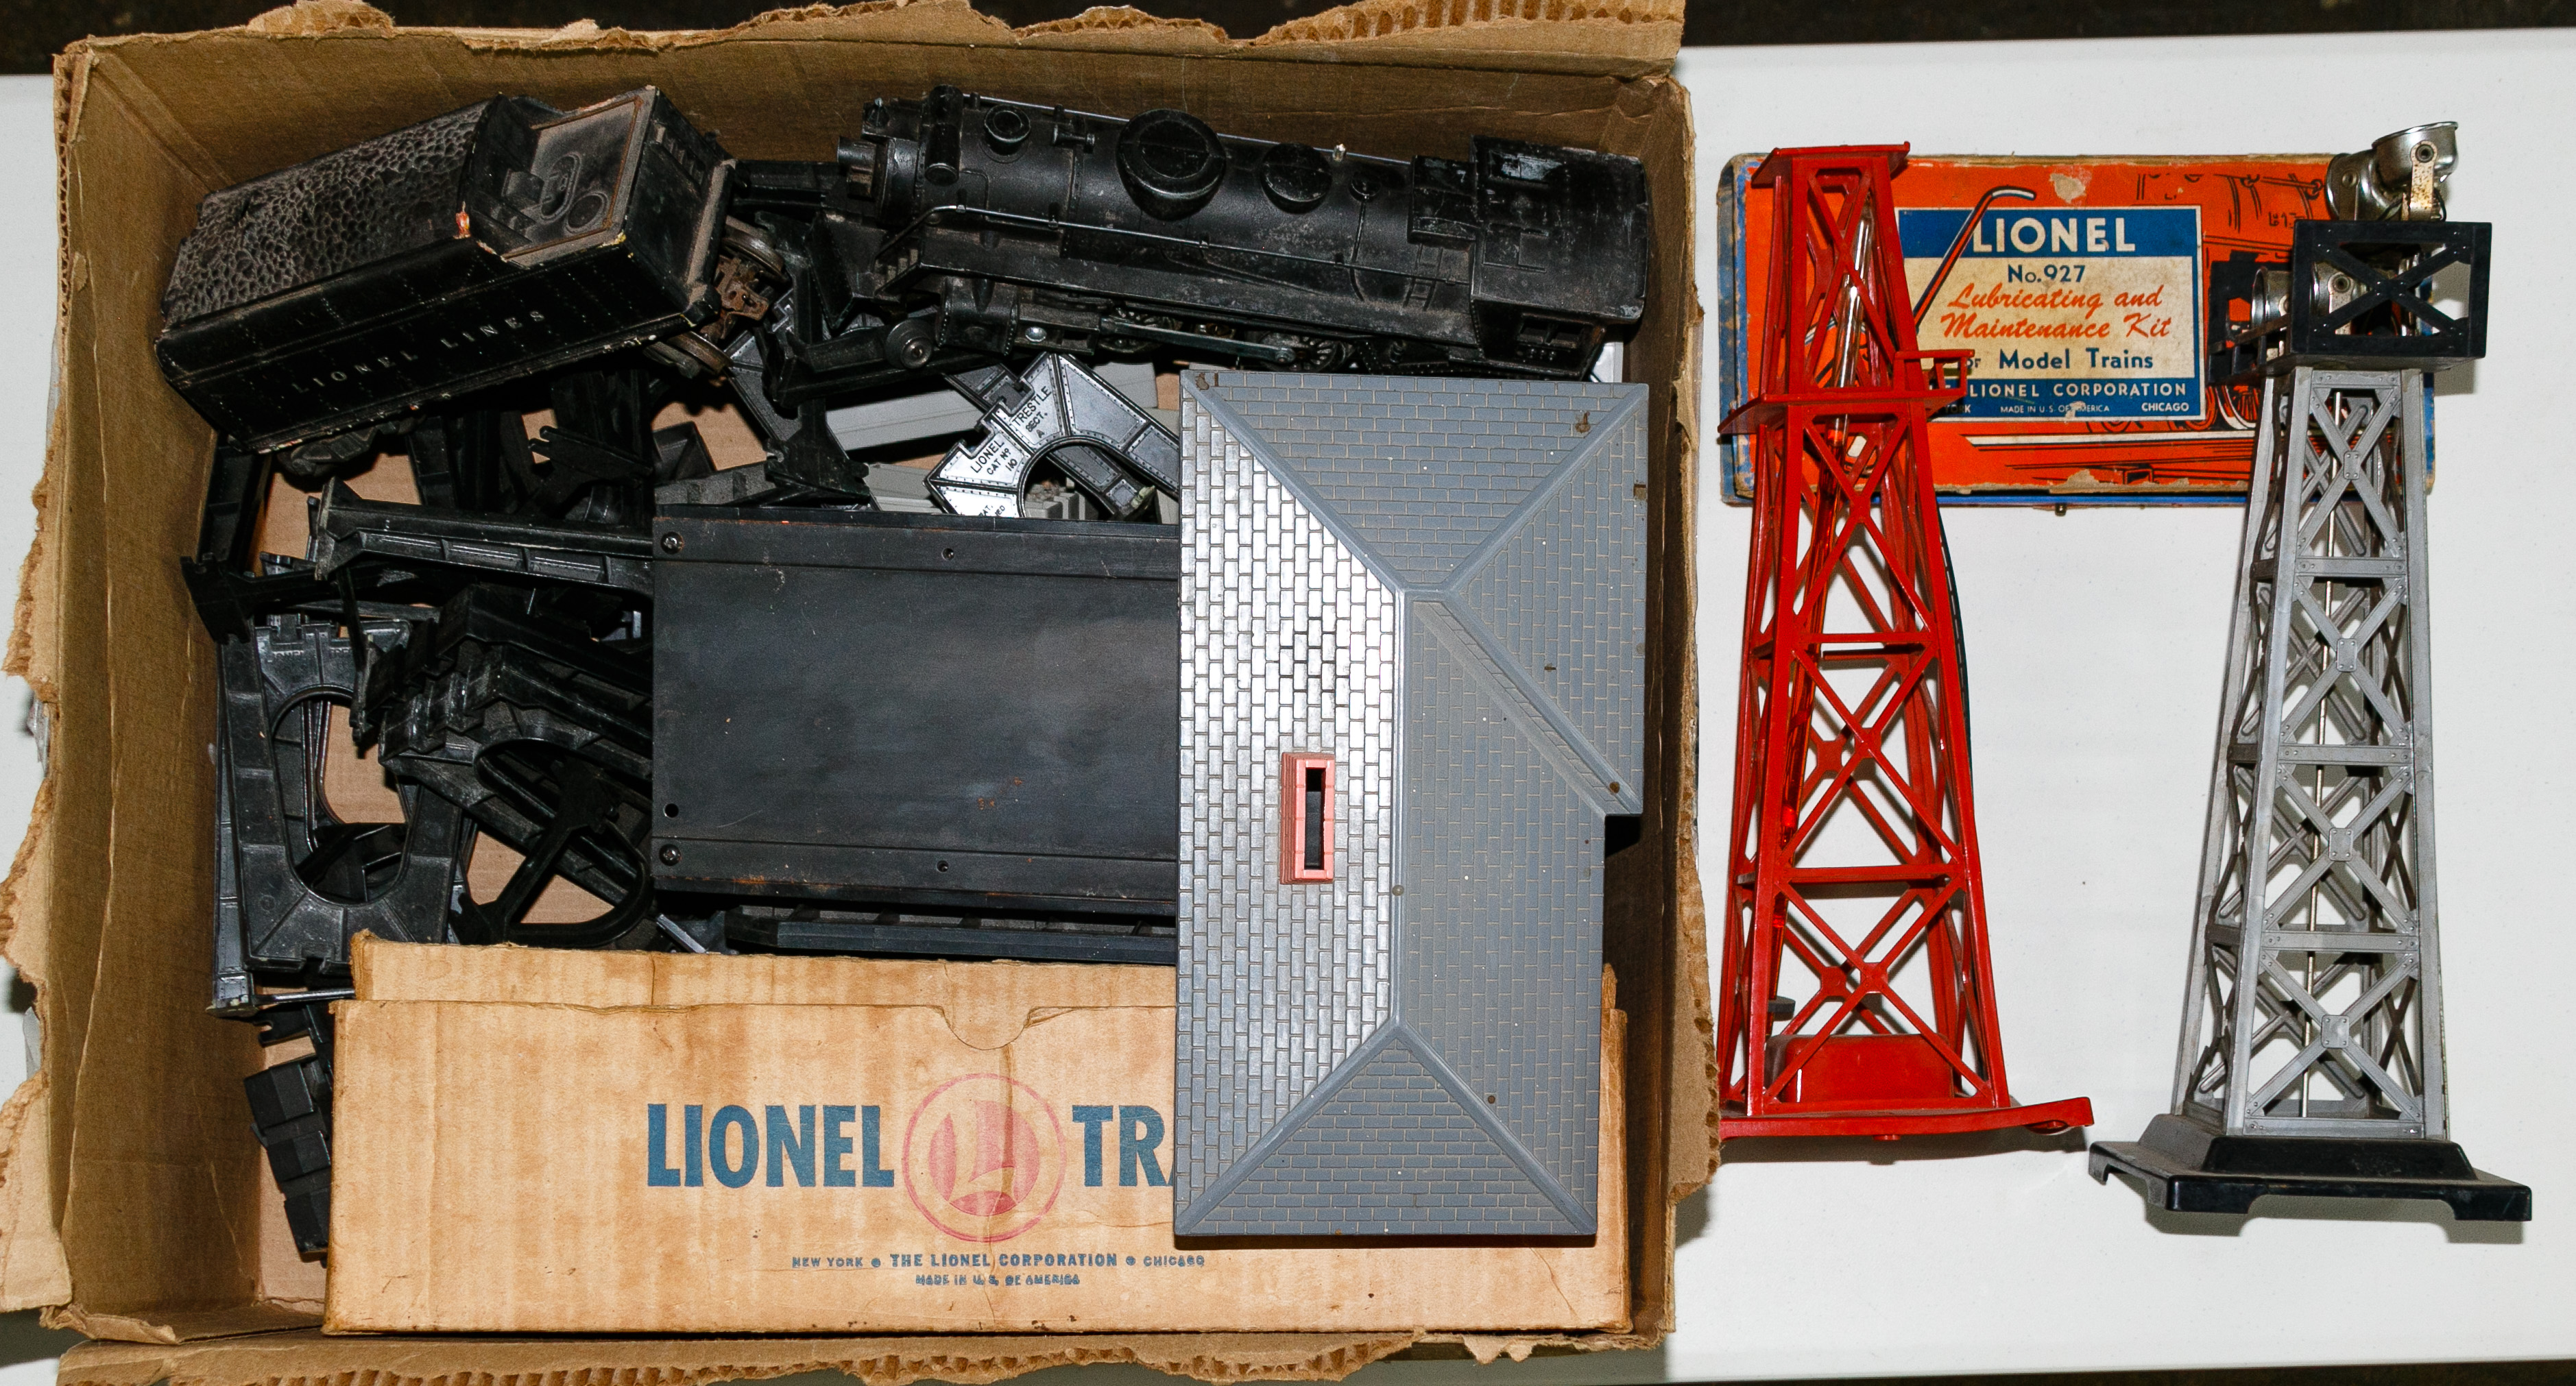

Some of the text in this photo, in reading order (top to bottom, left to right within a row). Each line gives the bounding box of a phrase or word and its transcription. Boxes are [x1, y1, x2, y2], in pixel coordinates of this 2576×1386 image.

[1972, 217, 2136, 253] LIONEL
[1947, 282, 2163, 319] Lubricating and
[1940, 312, 2172, 339] Maintenance Kit
[291, 310, 546, 393] LIONEL LINES
[1958, 347, 2153, 369] or Model Trains
[1969, 382, 2186, 398] LIONEL CORPORATION
[1011, 385, 1052, 426] TRESTLE
[2000, 404, 2024, 414] MADE
[2141, 402, 2190, 412] CHICAGO
[970, 439, 1005, 474] LIONEL
[986, 458, 1002, 475] CAT
[647, 1104, 894, 1188] LIONEL
[1072, 1105, 1175, 1187] TR
[792, 1253, 1205, 1267] NEW YORK THE LIONEL CORPORATION CHICAGO
[915, 1274, 950, 1286] MADE
[954, 1274, 967, 1285] IN
[1004, 1274, 1022, 1286] OF
[1025, 1274, 1081, 1285] AMERICA
